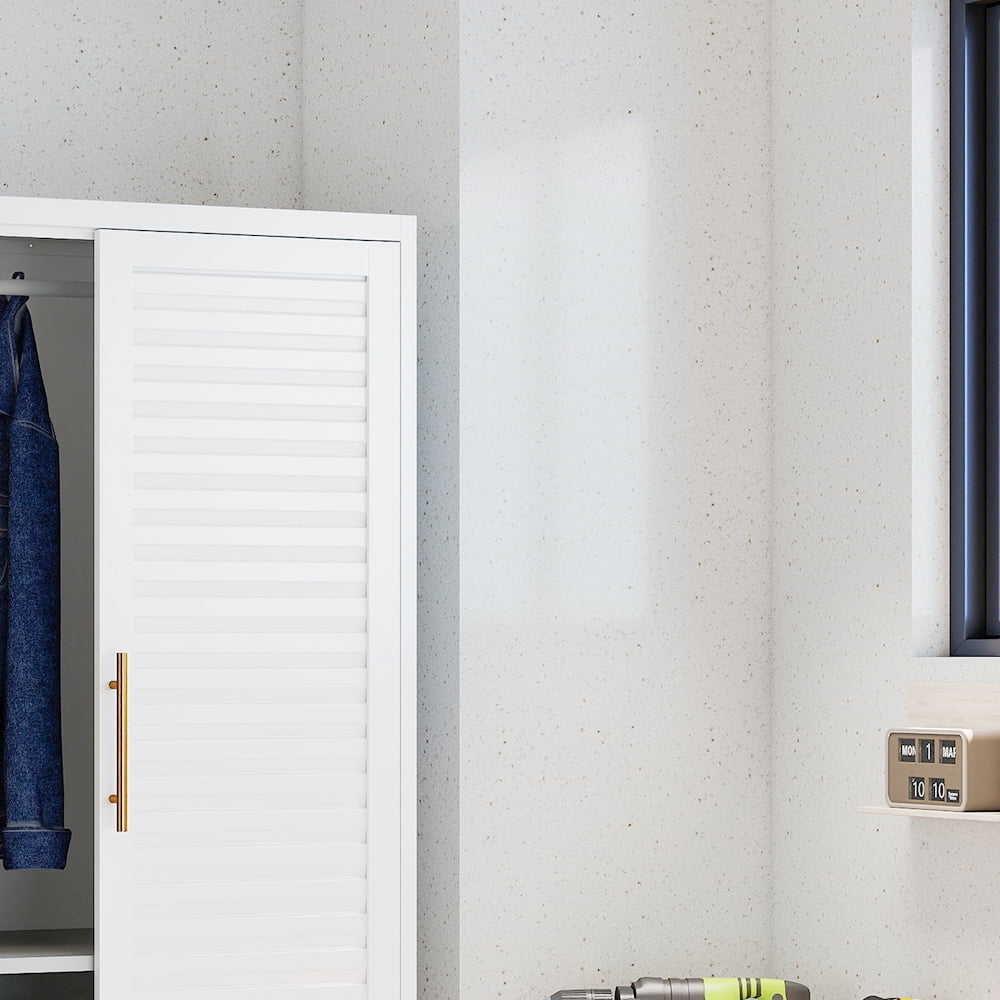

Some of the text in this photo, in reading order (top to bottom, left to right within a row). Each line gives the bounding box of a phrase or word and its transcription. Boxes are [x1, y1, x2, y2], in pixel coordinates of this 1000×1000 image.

[926, 743, 931, 760] 1
[912, 781, 925, 798] 10
[932, 782, 945, 799] 10
